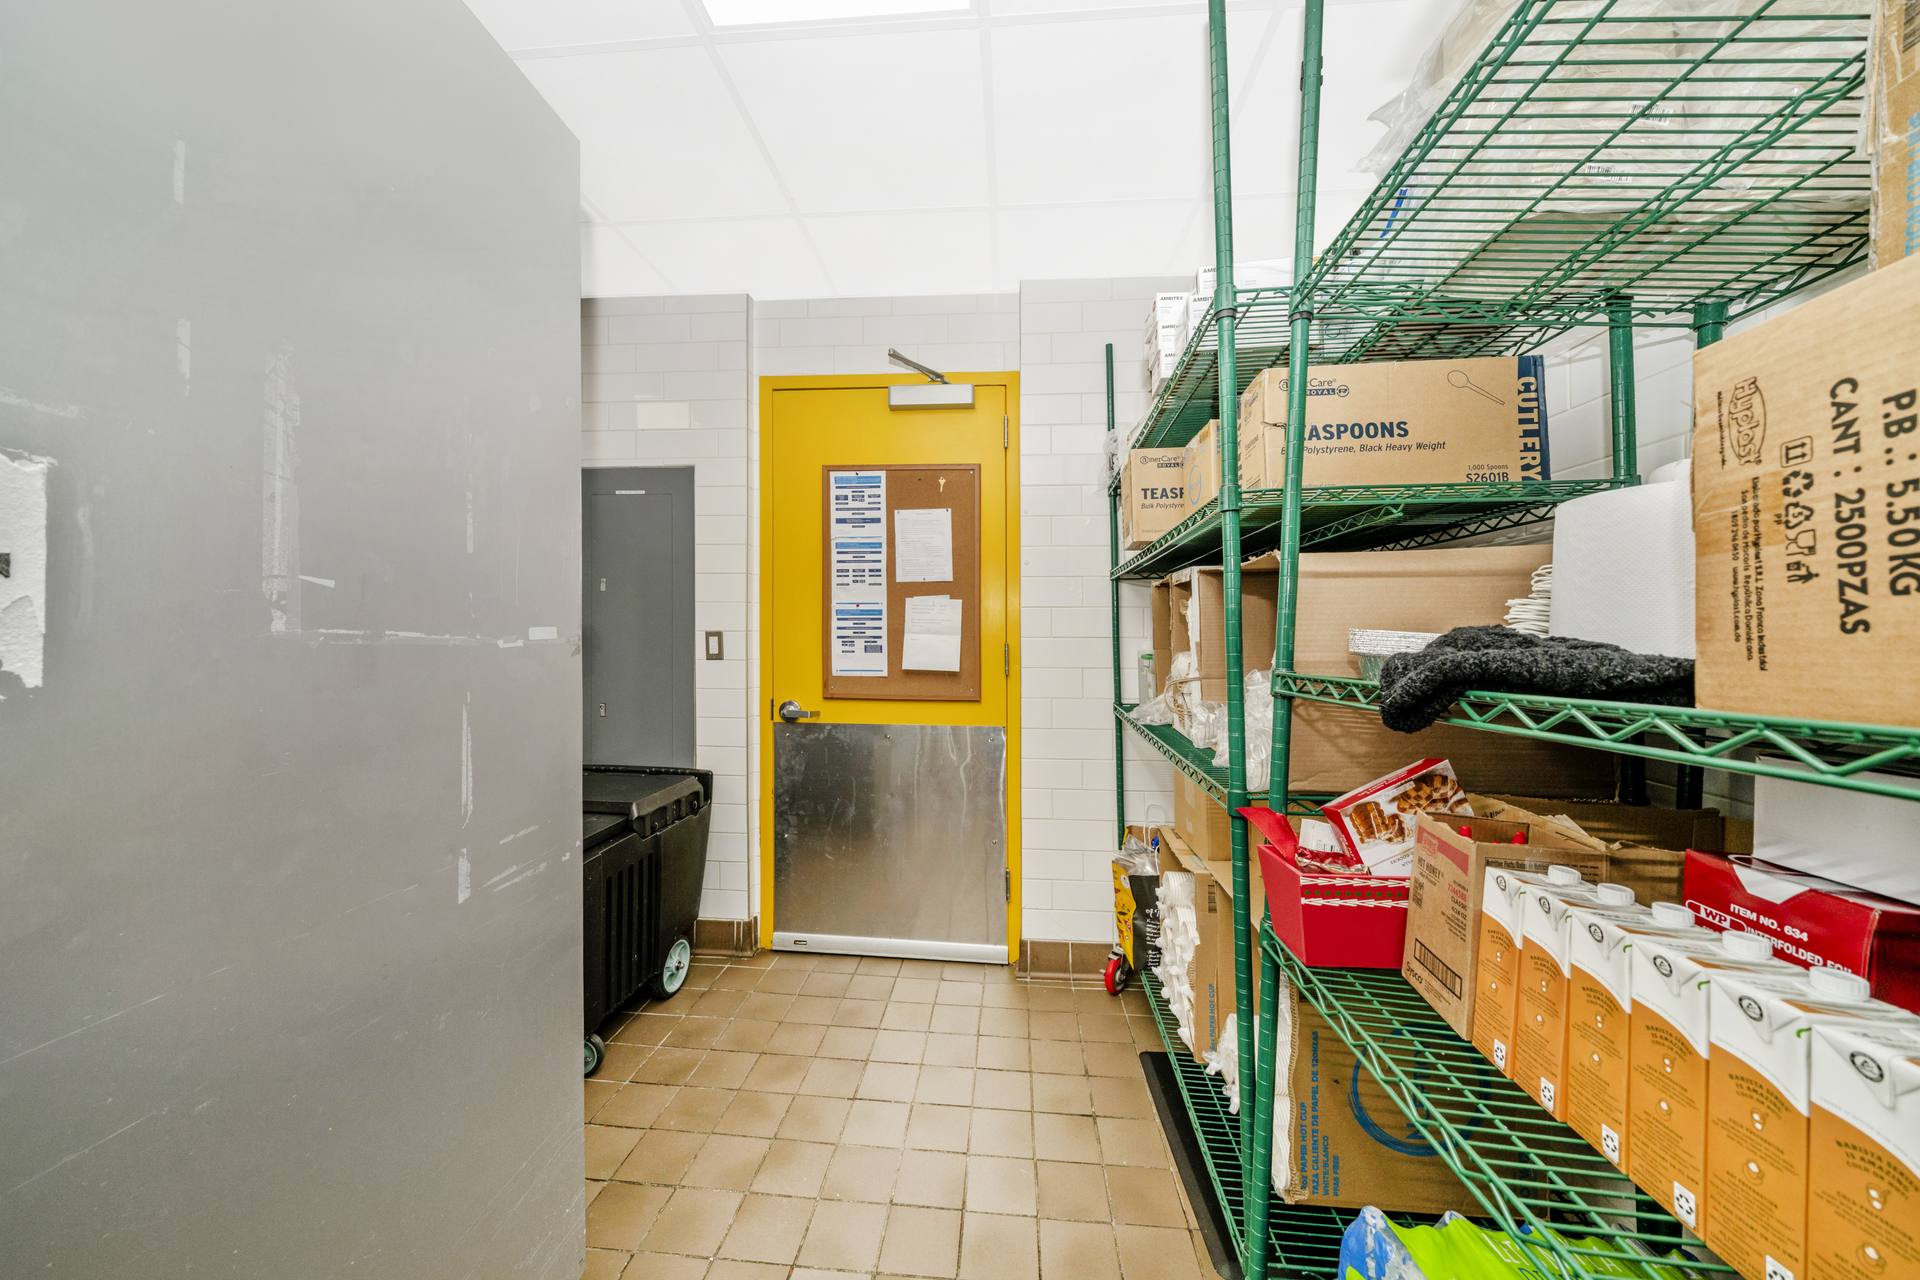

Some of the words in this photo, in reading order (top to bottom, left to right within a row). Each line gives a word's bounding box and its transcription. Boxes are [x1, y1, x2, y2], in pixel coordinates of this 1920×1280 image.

[1829, 376, 1862, 454] CANT
[1517, 376, 1542, 481] CUTLERY
[1359, 442, 1384, 452] Black
[1385, 442, 1414, 454] Heavy
[1415, 440, 1447, 452] Weight
[1465, 471, 1510, 483] S2601B
[1467, 464, 1485, 472] 1,000
[1486, 463, 1509, 471] Spoons
[1155, 502, 1184, 510] Polystyre
[1833, 486, 1871, 635] 2500PZAS
[1703, 907, 1728, 925] WP
[1729, 903, 1758, 921] ITEM
[1758, 915, 1782, 932] NO.
[1783, 924, 1809, 943] 634
[1311, 1071, 1319, 1082] DE
[1311, 1086, 1319, 1112] PAPEL
[1311, 1114, 1319, 1127] DE
[1300, 1144, 1308, 1173] PAPER
[1311, 1129, 1319, 1171] CALIENTE
[1311, 1173, 1319, 1196] TAZA
